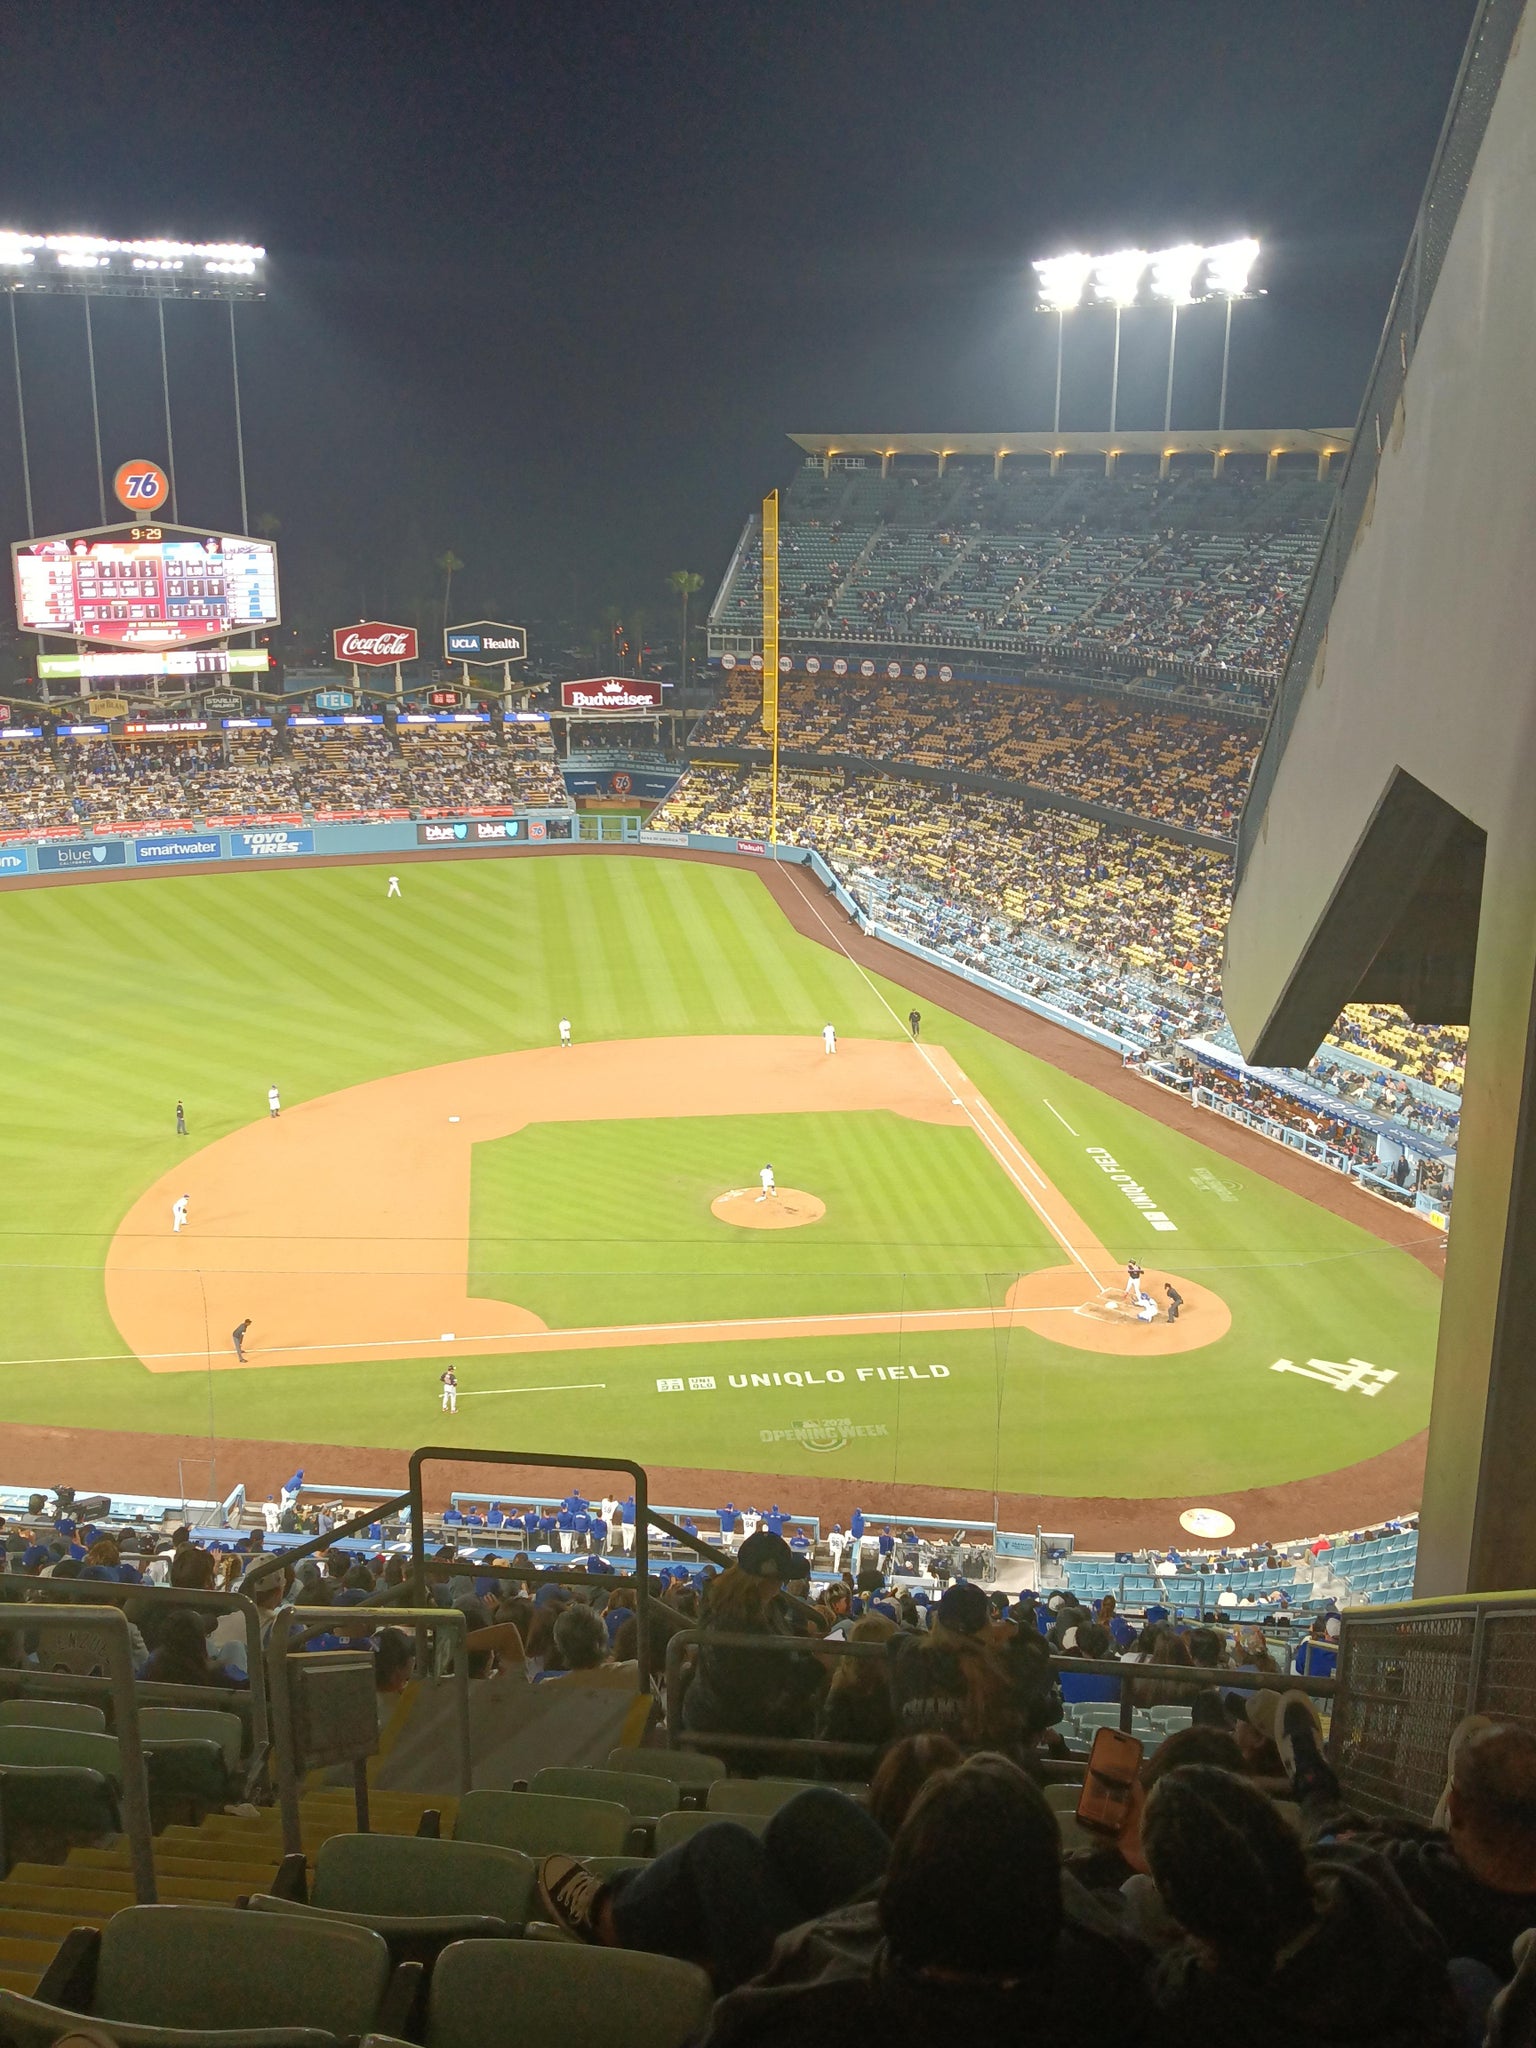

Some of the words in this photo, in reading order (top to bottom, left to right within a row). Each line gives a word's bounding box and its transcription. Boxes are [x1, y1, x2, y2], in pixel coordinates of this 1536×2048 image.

[125, 472, 159, 498] 76
[131, 528, 162, 540] 9:29
[343, 632, 410, 655] Coca-Cola
[451, 638, 478, 649] UCLA
[483, 637, 520, 649] Health
[321, 694, 350, 707] TEL
[572, 691, 653, 707] Budweiser
[616, 776, 630, 788] 76
[243, 832, 288, 845] TOYO
[532, 827, 543, 835] 76
[58, 849, 92, 862] blue
[140, 841, 216, 858] smartwater
[250, 841, 299, 855] TIRES
[1085, 1147, 1125, 1173] FIELD
[1110, 1174, 1158, 1209] UNIQLO
[728, 1369, 845, 1388] UNIQLO
[855, 1364, 951, 1381] FIELD
[759, 1427, 838, 1442] OPENING
[838, 1424, 888, 1438] WEEK
